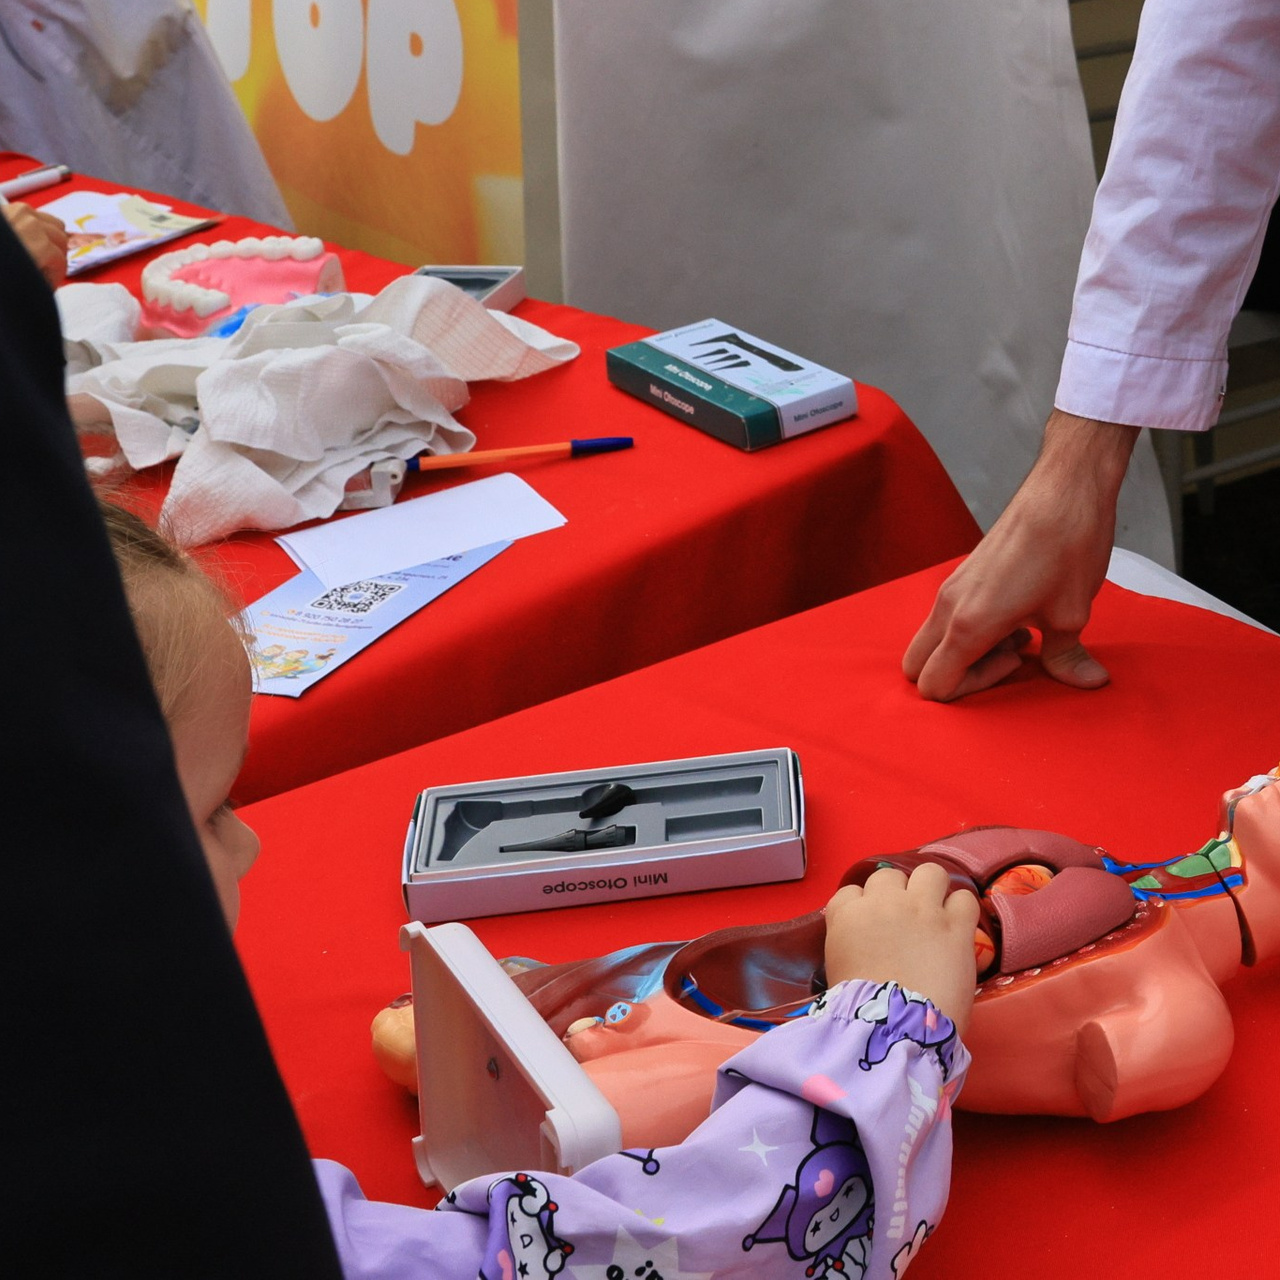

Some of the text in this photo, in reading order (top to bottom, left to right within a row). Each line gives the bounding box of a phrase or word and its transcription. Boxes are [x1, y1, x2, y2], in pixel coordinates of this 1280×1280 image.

[649, 383, 695, 415] Mini Otoscope
[793, 400, 843, 422] Mini Otoscope
[542, 872, 668, 895] Mini Otoscope
